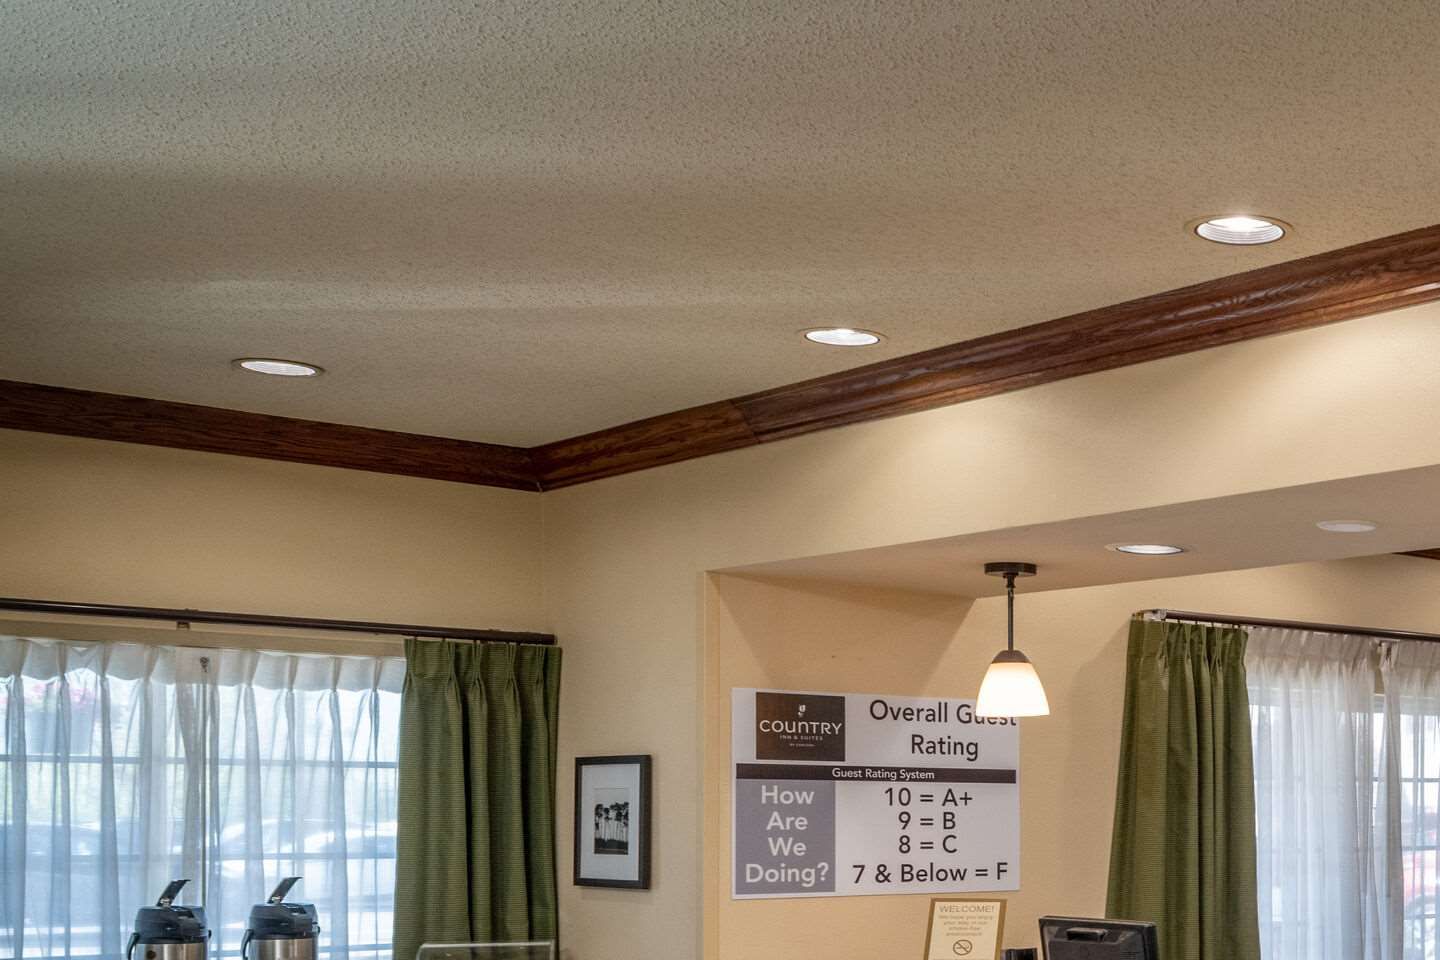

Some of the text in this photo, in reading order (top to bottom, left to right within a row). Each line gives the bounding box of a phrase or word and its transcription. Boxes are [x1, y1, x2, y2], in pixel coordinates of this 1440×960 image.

[869, 699, 948, 723] Overall
[759, 719, 843, 735] COUNTRY
[911, 734, 979, 761] Rating
[831, 767, 935, 781] Guest Rating System
[761, 785, 815, 804] How
[884, 787, 973, 806] 10 = A+
[766, 811, 808, 830] Are
[898, 811, 956, 830] 9 = B
[767, 837, 807, 856] We
[898, 834, 958, 854] 8 = C
[745, 862, 829, 887] Doing?
[852, 862, 1008, 884] 7 & Below = F
[939, 905, 994, 913] WELCOME!
